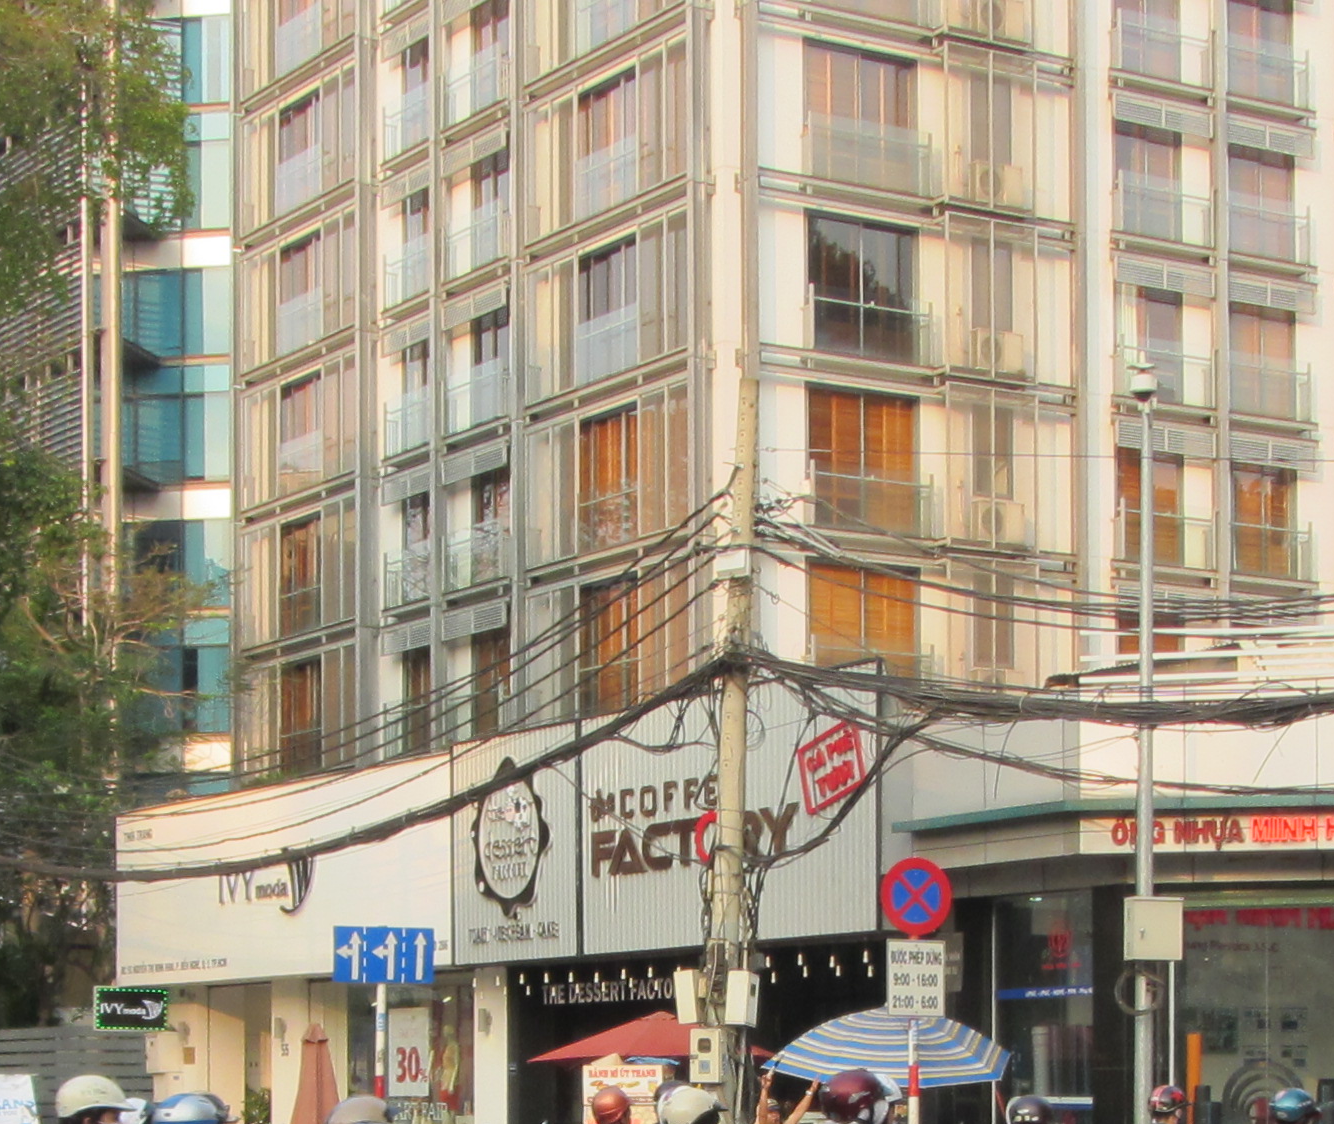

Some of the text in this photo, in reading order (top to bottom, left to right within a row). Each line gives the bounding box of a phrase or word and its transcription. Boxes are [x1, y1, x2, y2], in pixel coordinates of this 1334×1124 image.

[1250, 815, 1317, 842] MINH
[219, 870, 257, 905] IVY
[542, 984, 565, 1005] THE
[568, 980, 626, 1004] DESSERT
[100, 1003, 124, 1014] IVY
